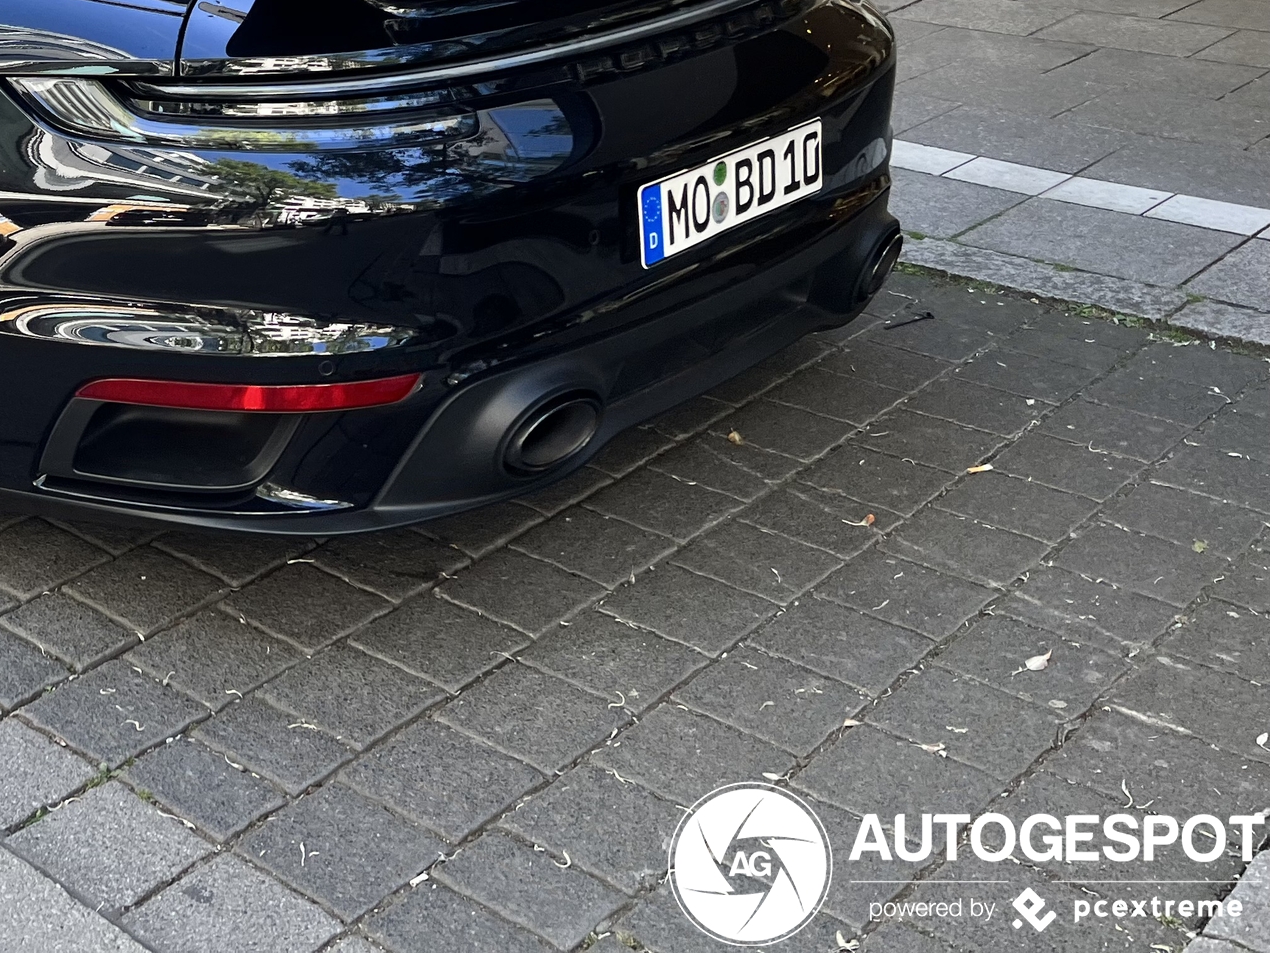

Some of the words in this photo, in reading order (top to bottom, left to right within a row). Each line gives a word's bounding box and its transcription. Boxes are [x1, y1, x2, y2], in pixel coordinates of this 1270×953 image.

[649, 231, 658, 250] D
[667, 175, 711, 246] MO
[735, 148, 776, 216] BD
[783, 130, 820, 196] 10
